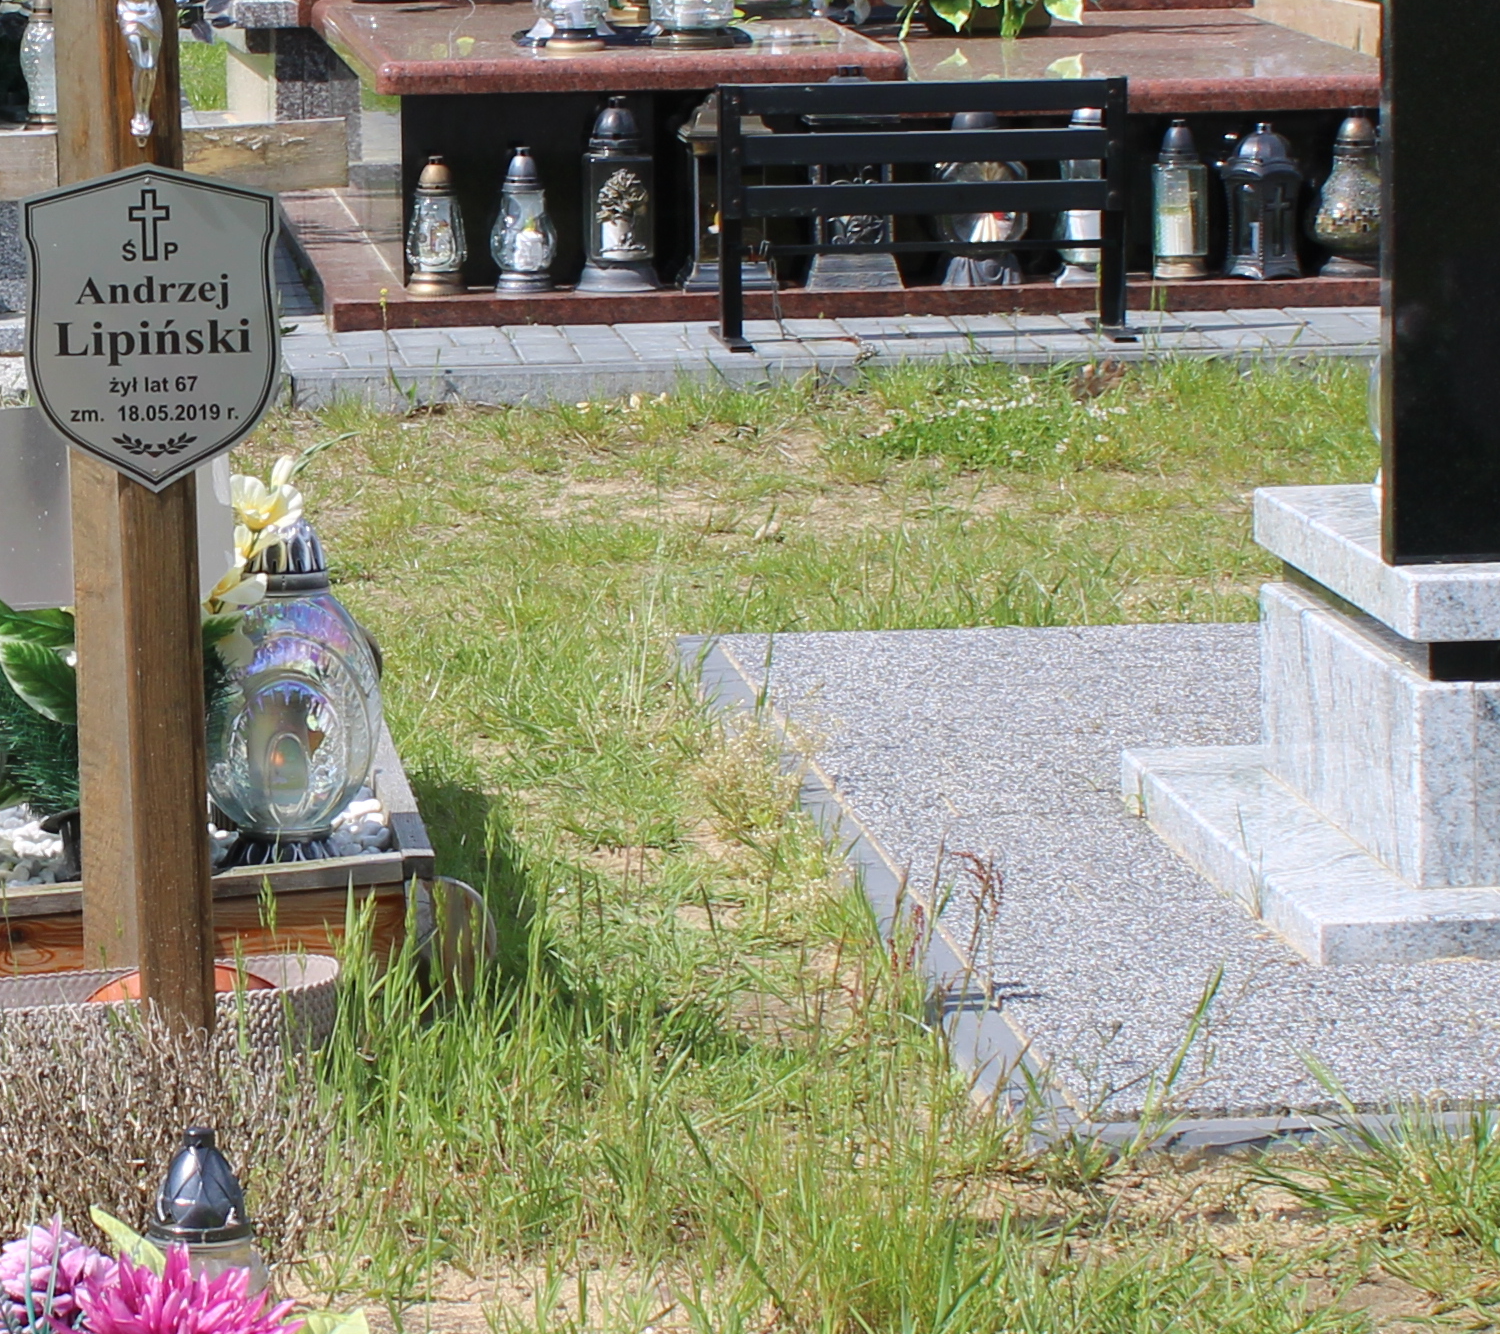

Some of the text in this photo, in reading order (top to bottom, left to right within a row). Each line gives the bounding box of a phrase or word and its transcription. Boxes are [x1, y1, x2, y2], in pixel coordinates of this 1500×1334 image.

[122, 239, 178, 261] Ś P
[75, 273, 229, 310] Andrzej
[53, 318, 252, 367] Lipiński
[109, 375, 198, 397] żył lat 67
[70, 403, 240, 423] zm. 18.05.2019 r.
